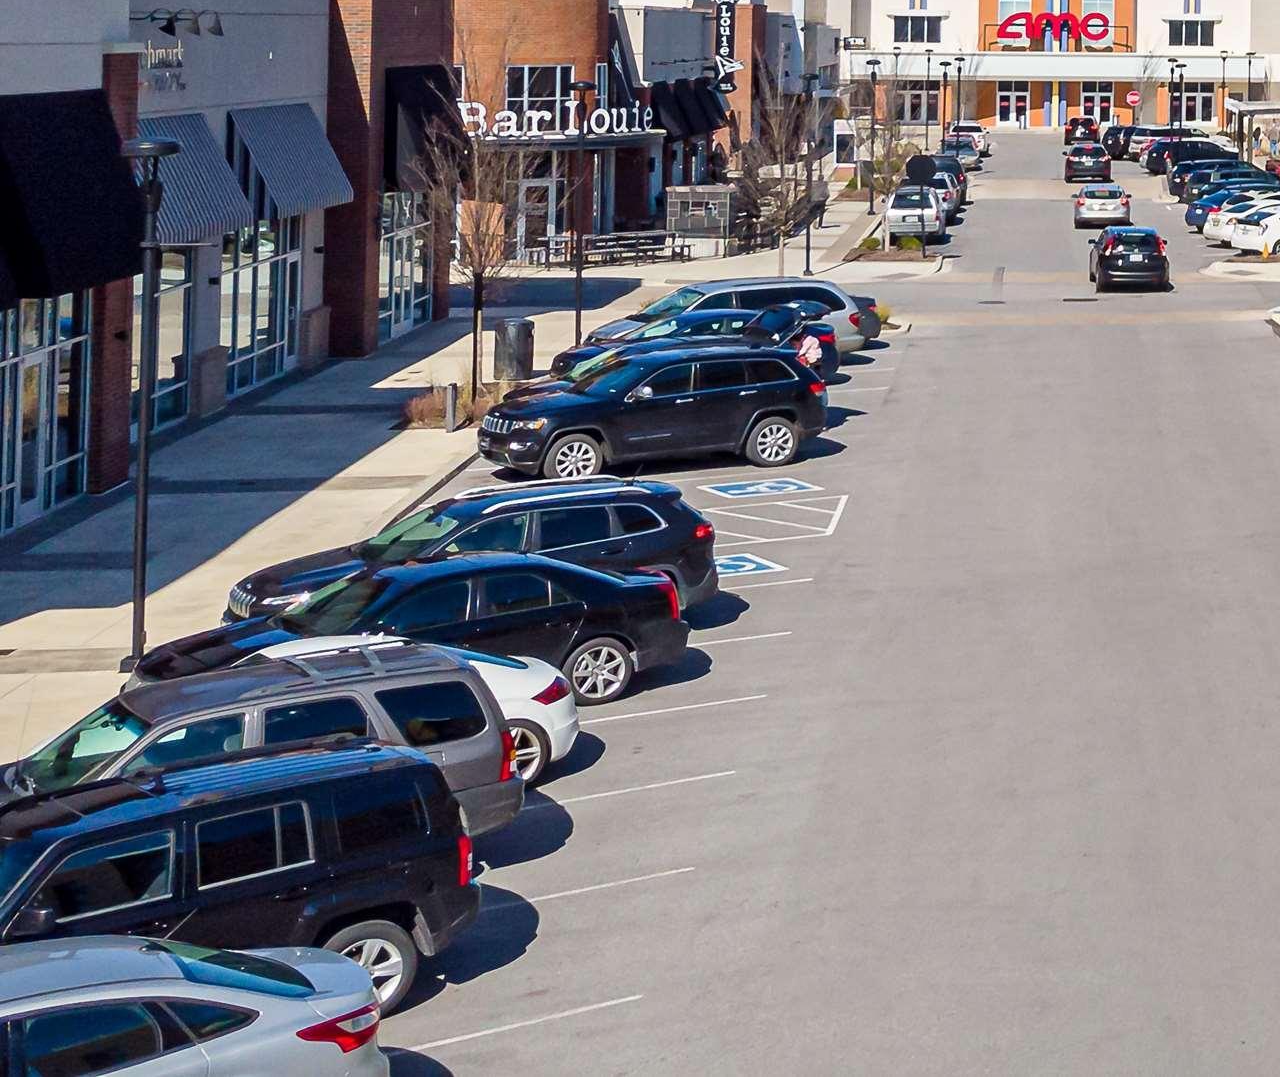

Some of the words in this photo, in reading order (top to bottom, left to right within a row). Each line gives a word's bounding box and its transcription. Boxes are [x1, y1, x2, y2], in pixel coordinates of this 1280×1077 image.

[719, 4, 732, 56] Louie
[456, 101, 553, 140] Bar
[564, 99, 654, 136] Louie
